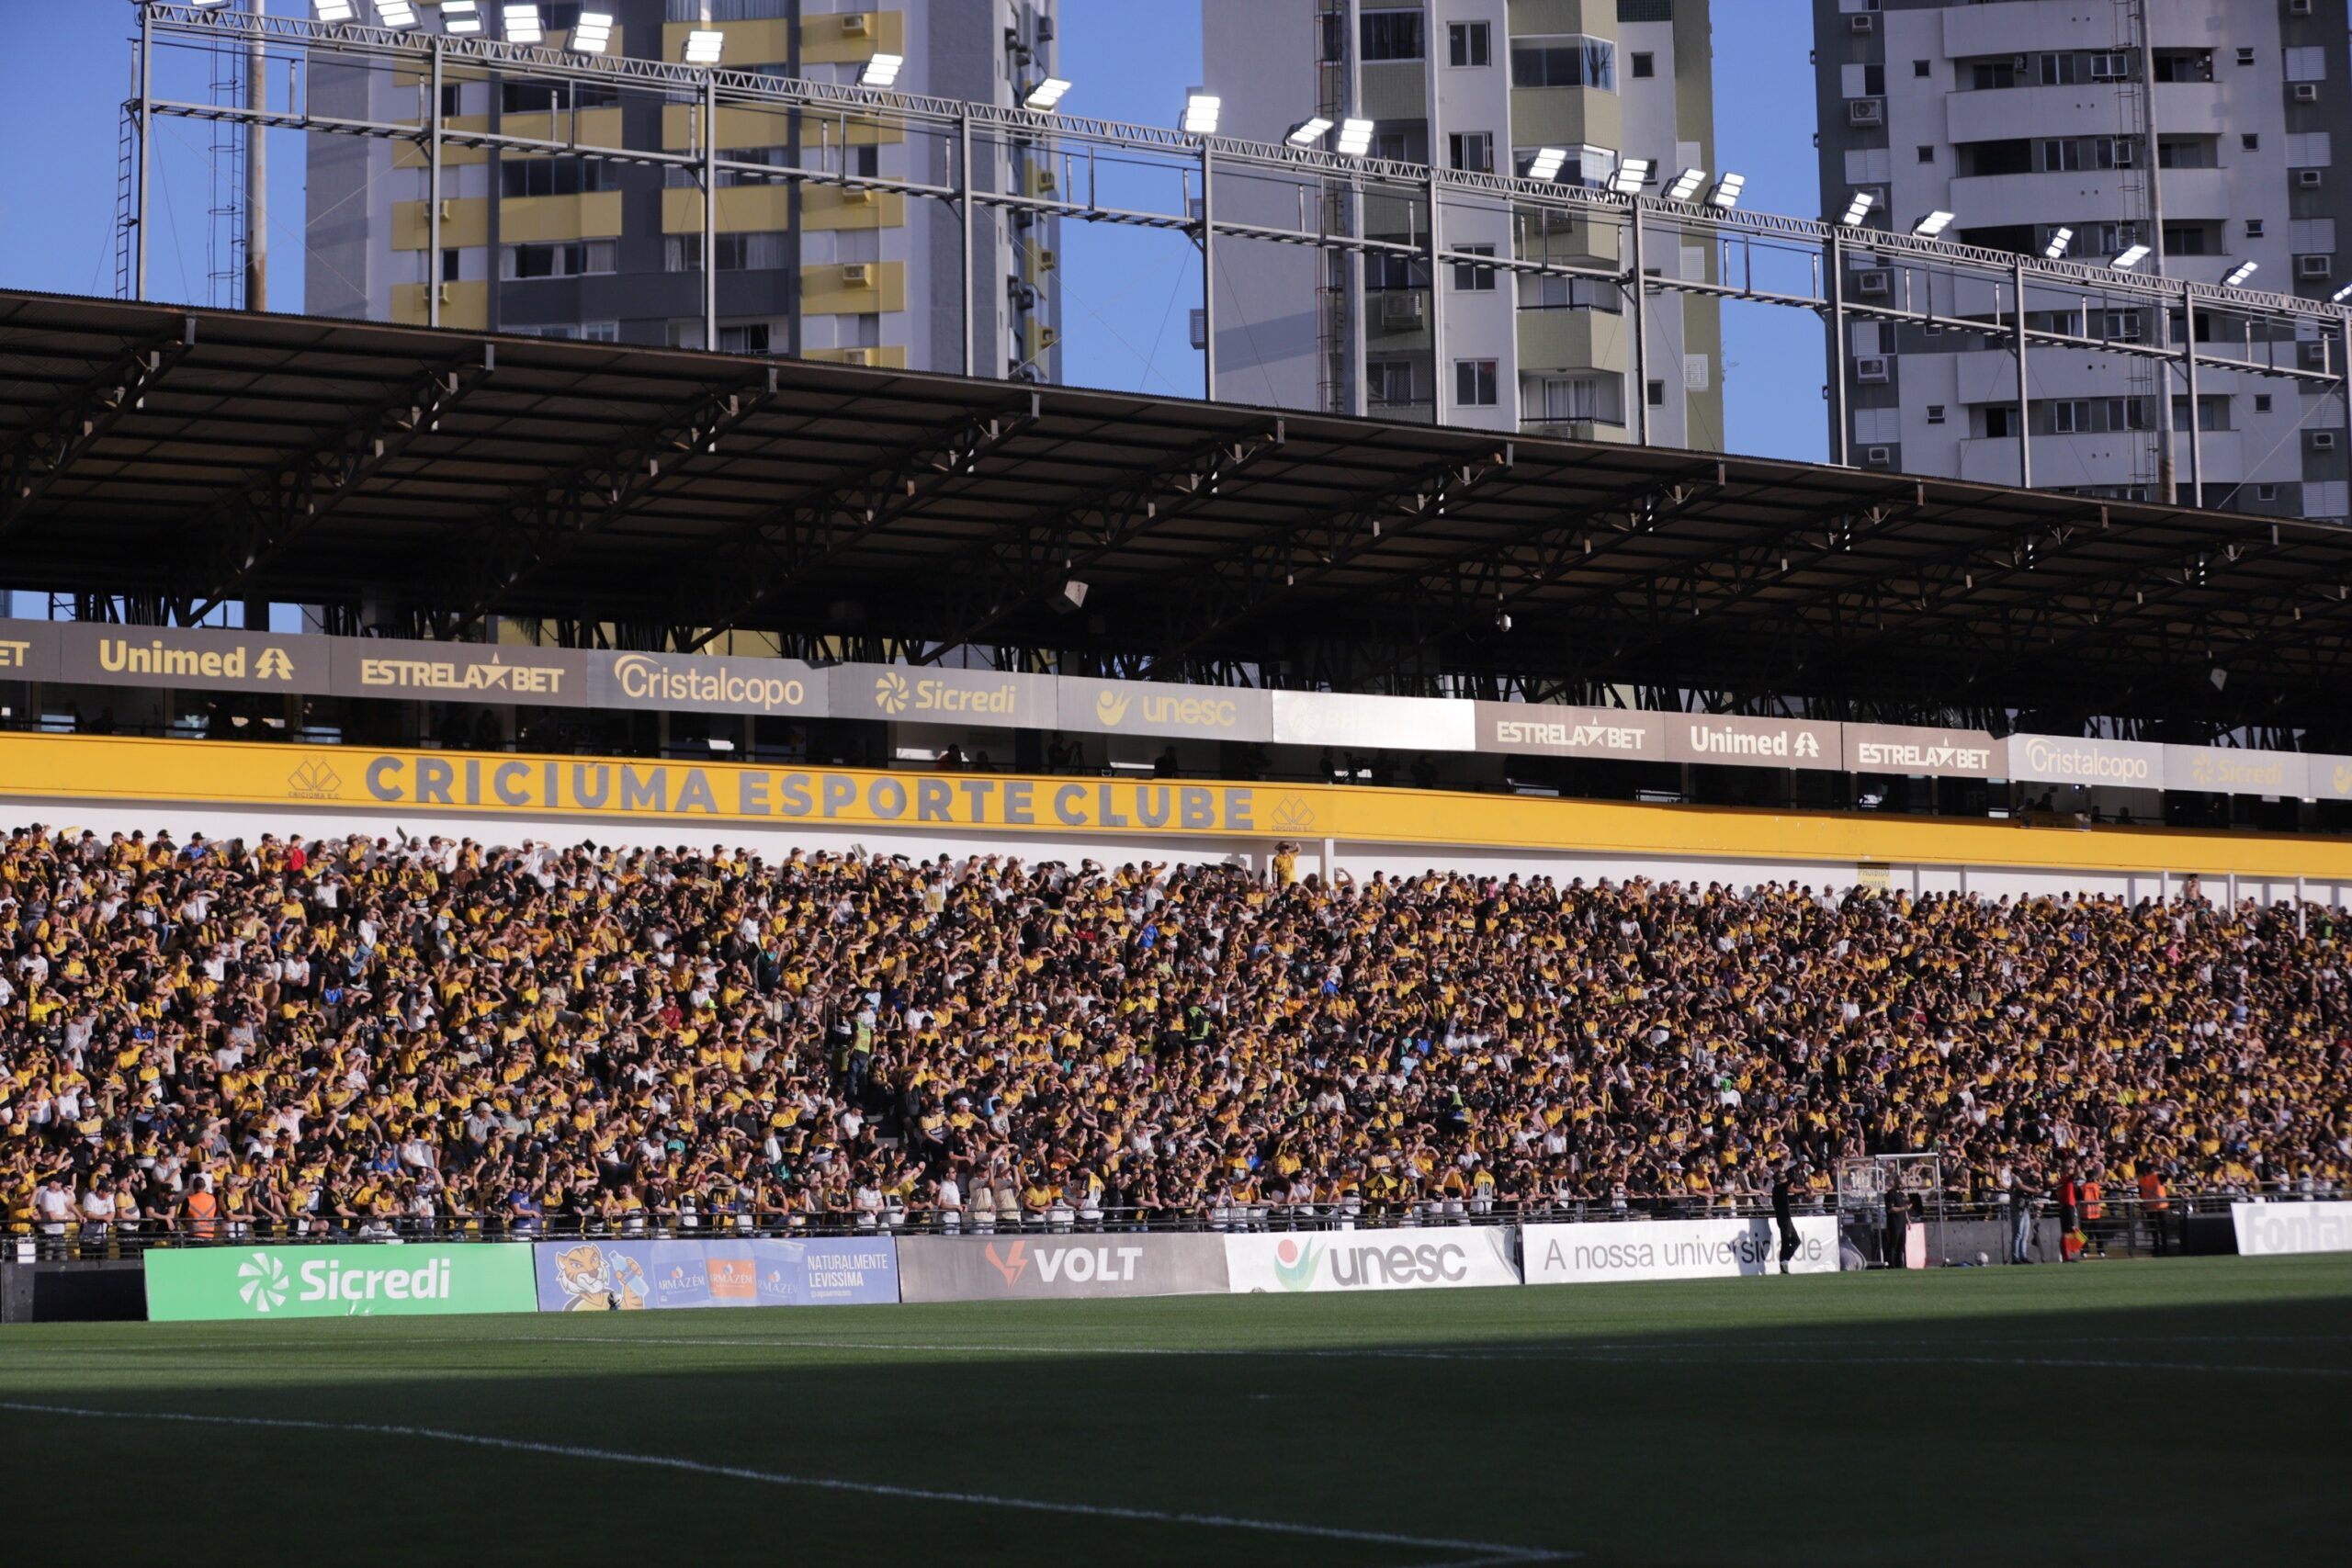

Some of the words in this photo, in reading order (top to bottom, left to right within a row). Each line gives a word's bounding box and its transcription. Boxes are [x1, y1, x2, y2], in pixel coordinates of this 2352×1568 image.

[100, 639, 245, 679] Unimed
[616, 654, 804, 711] Cristalcopo
[916, 680, 1016, 714] Sicredi
[1143, 694, 1237, 727] unesc
[1690, 726, 1788, 757] Unimed
[2026, 738, 2148, 783] Cristalcopo
[2218, 758, 2283, 786] Sicredi
[366, 756, 718, 813] CRICIÚMA
[739, 771, 1035, 824] ESPORTE
[1054, 784, 1254, 830] CLUBE
[808, 1254, 888, 1270] NATURALMENTE
[1035, 1247, 1143, 1282] VOLT
[1331, 1243, 1467, 1287] unesc
[1544, 1238, 1566, 1270] A
[1575, 1243, 1655, 1269] nossa
[1664, 1231, 1822, 1267] universidde
[300, 1258, 450, 1302] Sicredi
[808, 1269, 865, 1288] LEVISSÍMA
